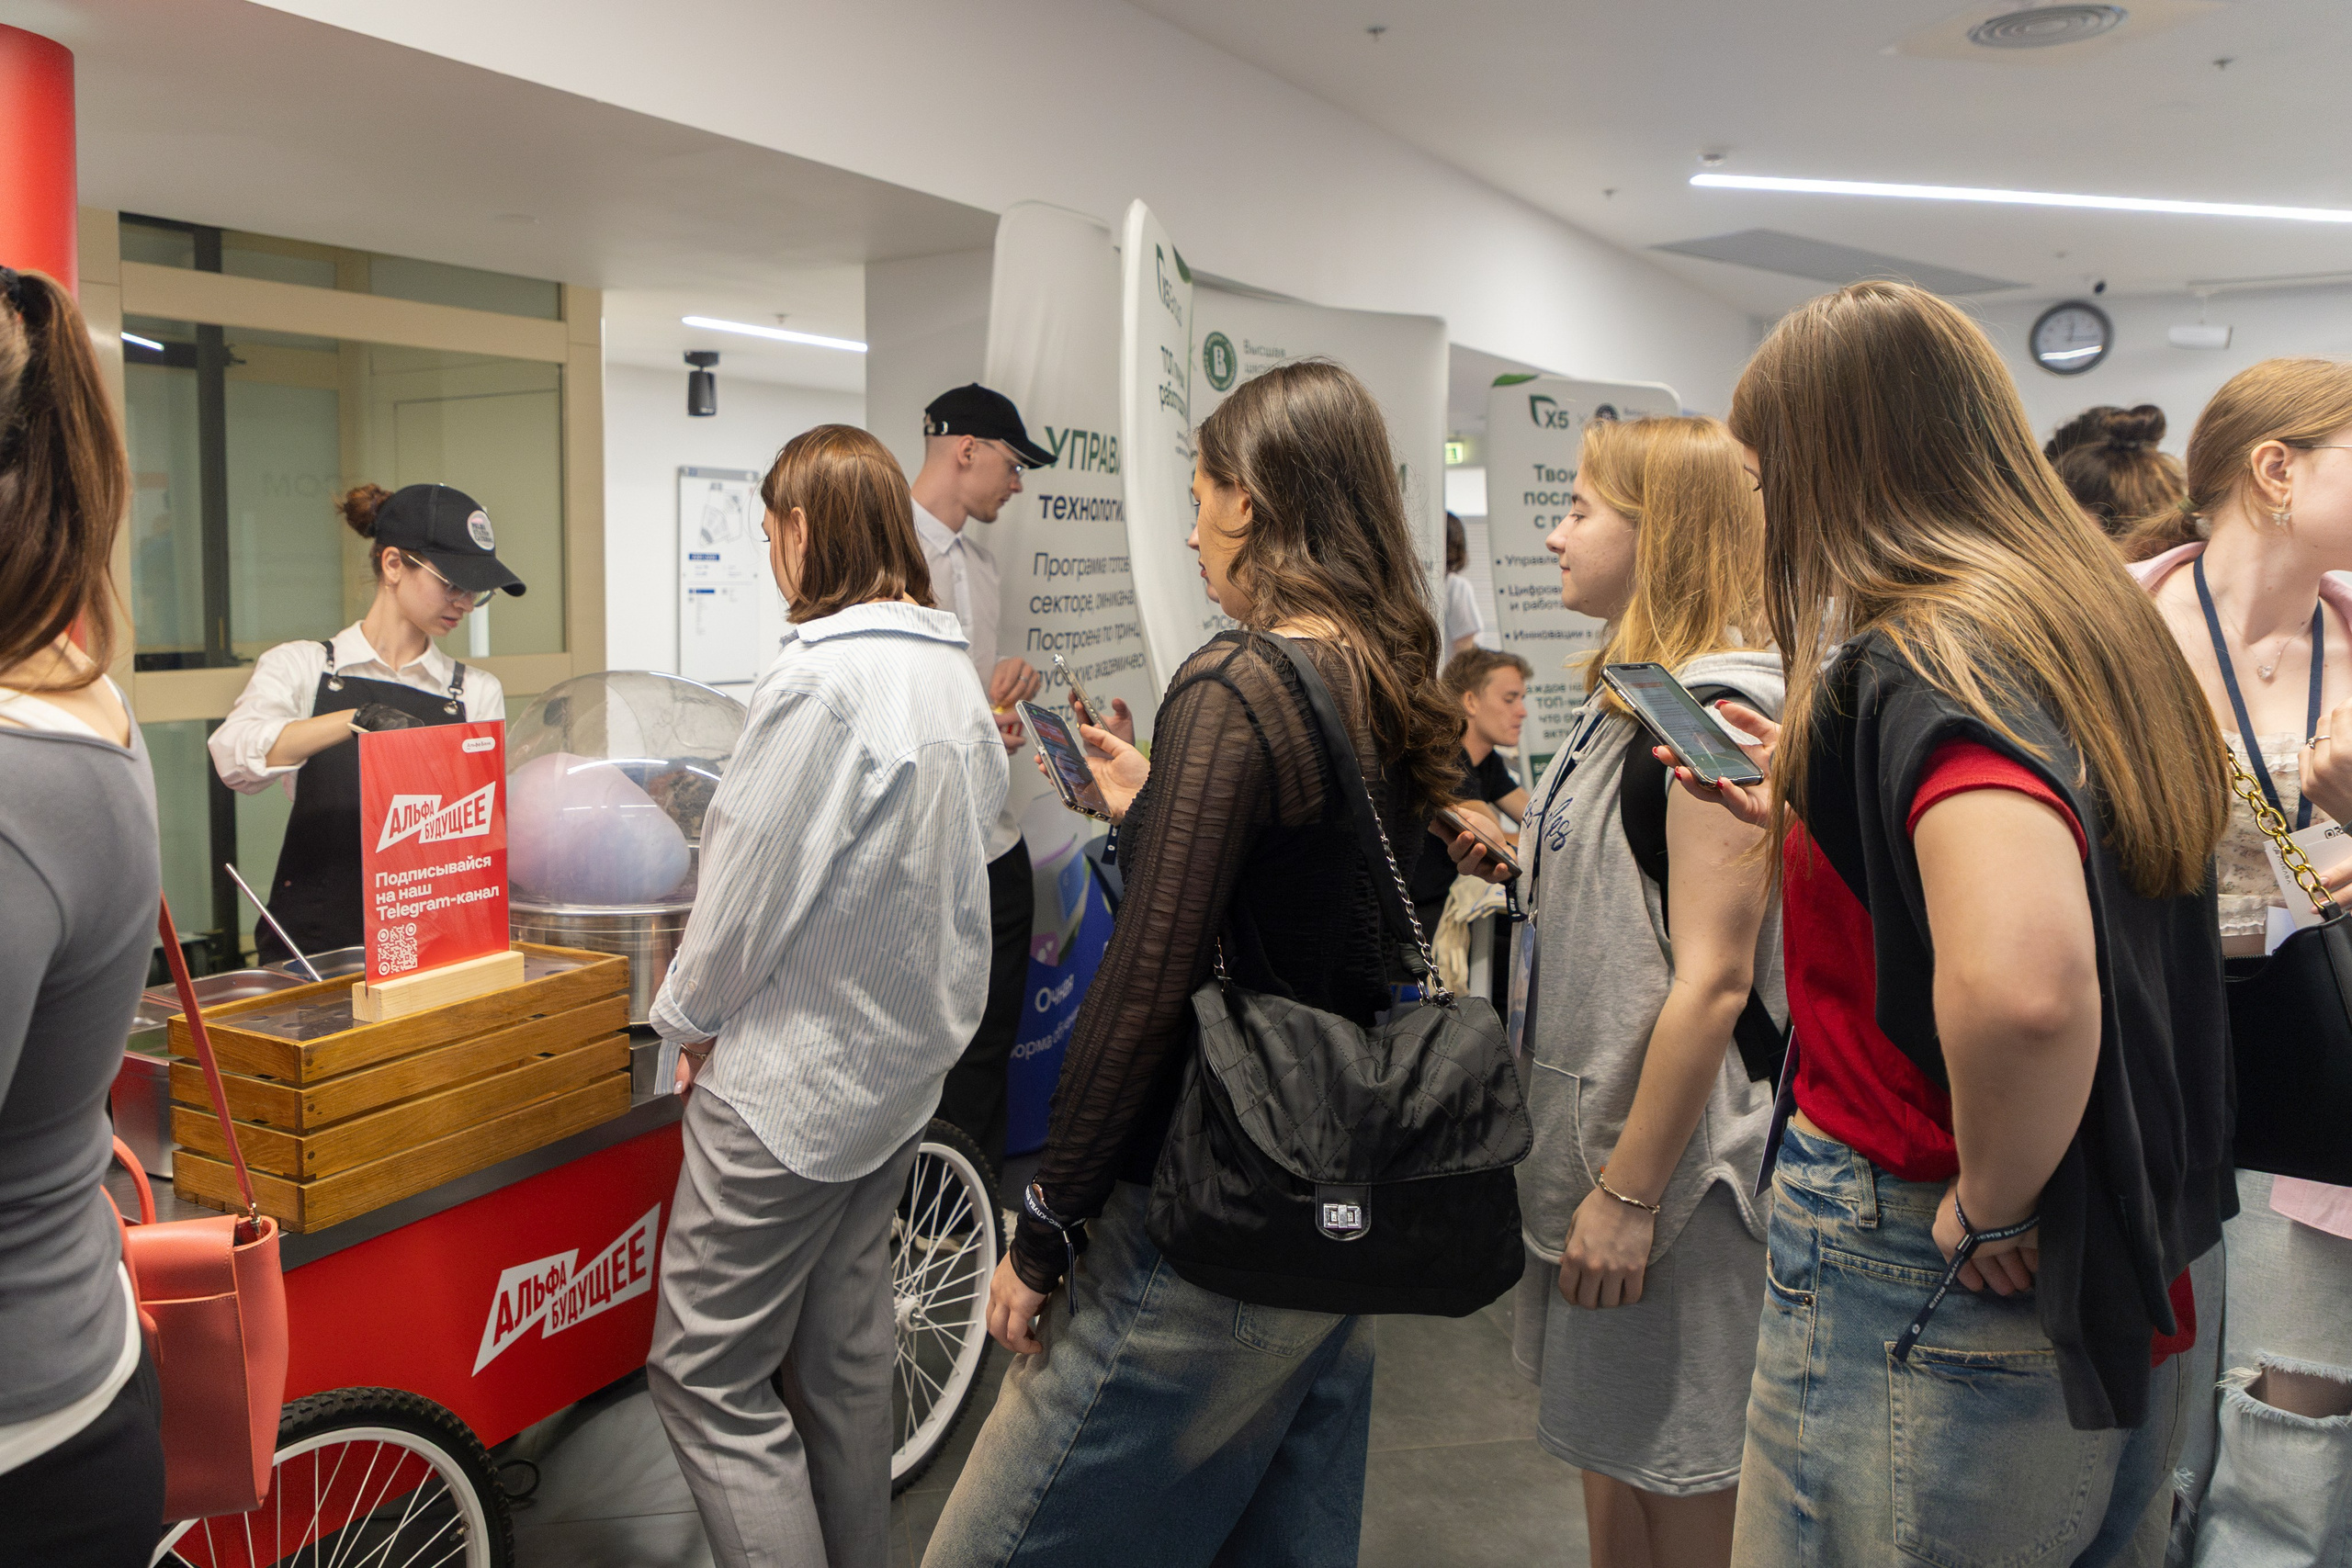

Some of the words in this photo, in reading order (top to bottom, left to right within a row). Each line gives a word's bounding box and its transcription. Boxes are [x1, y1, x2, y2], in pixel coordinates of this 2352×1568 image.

[388, 798, 435, 840] АЛЬФА
[424, 793, 487, 840] БУДУЩЕЕ
[375, 855, 492, 888] Подписывайся
[375, 889, 397, 905] на
[398, 884, 432, 900] наш
[376, 885, 500, 921] Telegram-канал
[551, 1224, 647, 1330] БУДУЩЕЕ
[492, 1259, 568, 1348] АЛЬФА
